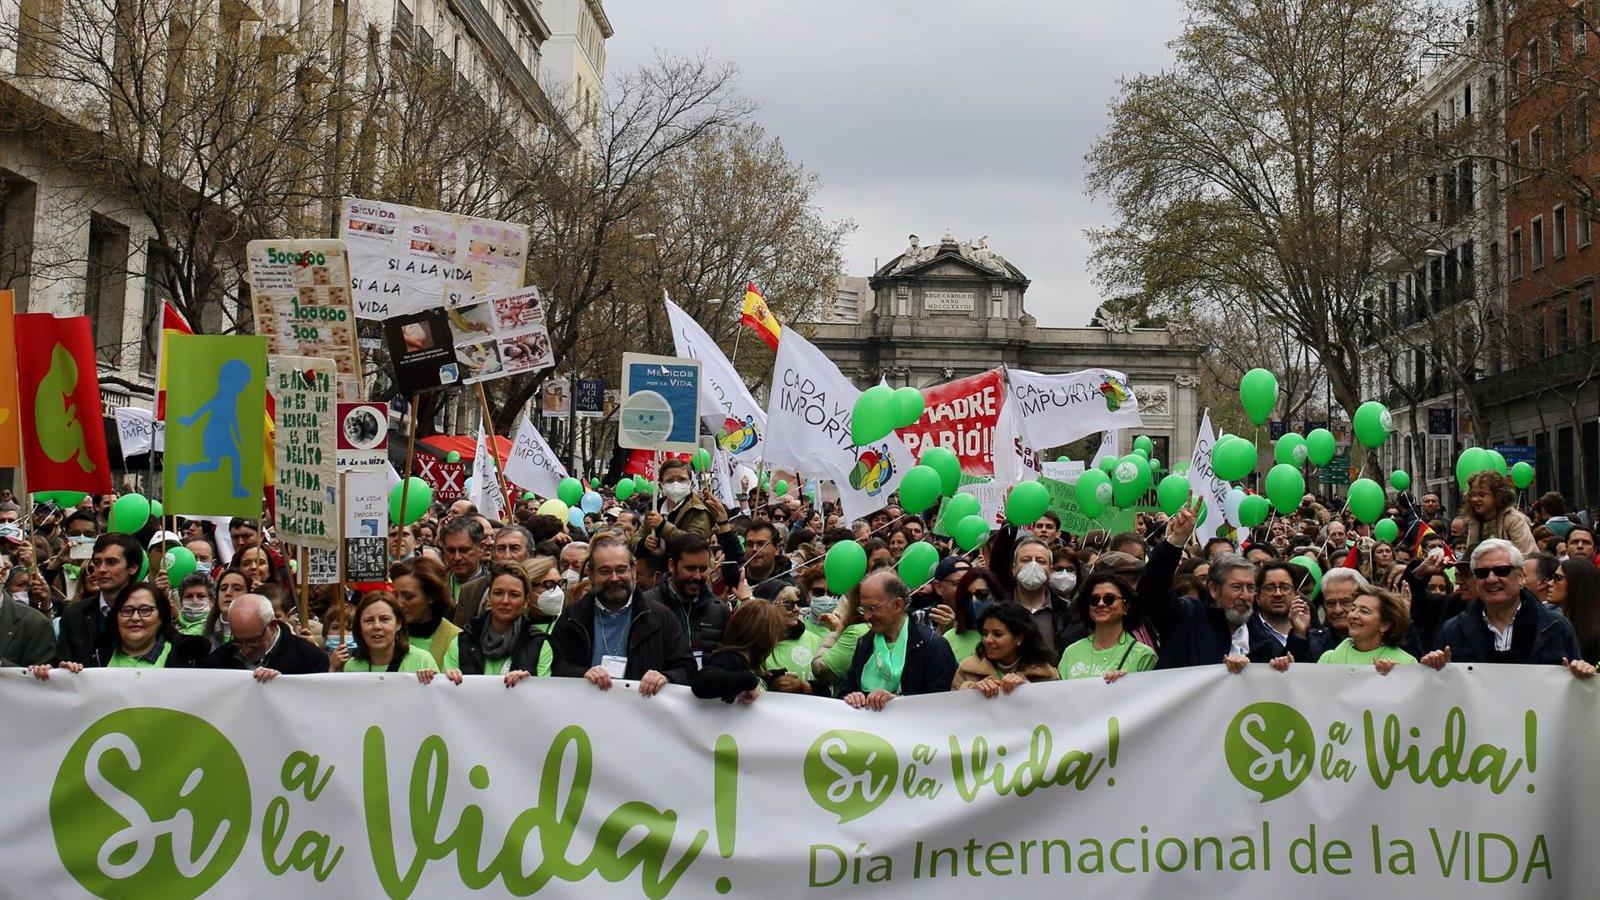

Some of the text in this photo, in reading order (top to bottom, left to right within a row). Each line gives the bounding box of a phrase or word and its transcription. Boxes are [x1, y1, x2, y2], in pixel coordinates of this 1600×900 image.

[405, 261, 415, 273] A
[421, 264, 438, 277] LA
[443, 268, 473, 283] VIDA
[368, 280, 378, 293] A
[383, 281, 400, 296] LA
[290, 296, 347, 322] 100000
[358, 301, 389, 315] VIDA
[291, 324, 318, 340] 300
[291, 368, 330, 393] ATO
[669, 379, 694, 388] VIDA
[784, 368, 826, 408] CADA
[1016, 383, 1055, 400] CA
[296, 393, 306, 410] ES
[316, 396, 328, 413] UN
[283, 412, 318, 428] DERECHO
[781, 387, 860, 462] IMPORTA
[290, 429, 319, 445] ES UN
[286, 443, 322, 465] DELITO
[416, 453, 436, 461] VELA
[281, 468, 320, 491] LA VIDA
[418, 458, 436, 480] X
[440, 470, 461, 491] X
[296, 496, 308, 513] ES
[311, 500, 323, 515] UN
[1329, 721, 1352, 745] a
[912, 744, 938, 766] a
[1240, 713, 1306, 781] Sí
[1363, 706, 1537, 795] Vida!
[820, 738, 889, 802] Sí
[949, 717, 1120, 803] Vida!
[1320, 743, 1357, 783] la
[281, 750, 336, 801] a
[903, 763, 943, 800] la
[84, 732, 232, 880] Sí
[363, 725, 739, 900] Vida!
[261, 796, 345, 883] la
[808, 821, 1552, 888] Día Internacional de la VIDA
